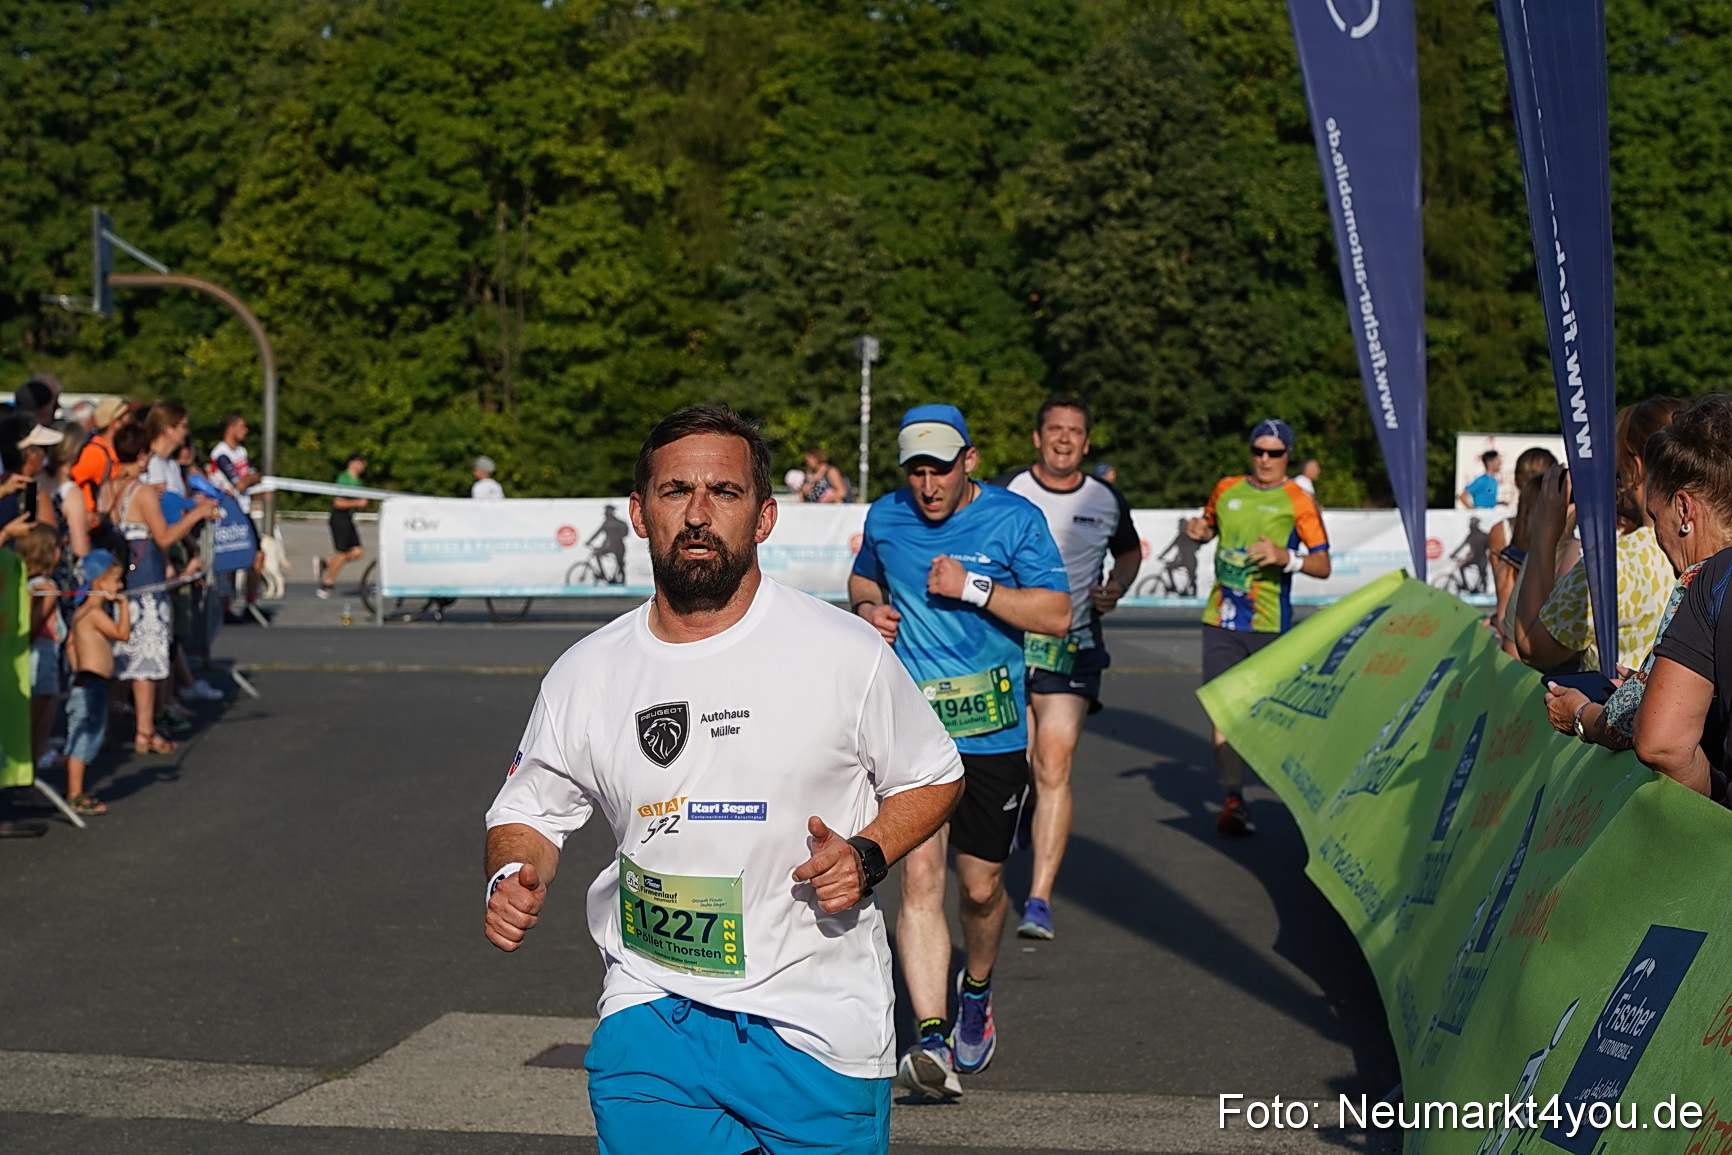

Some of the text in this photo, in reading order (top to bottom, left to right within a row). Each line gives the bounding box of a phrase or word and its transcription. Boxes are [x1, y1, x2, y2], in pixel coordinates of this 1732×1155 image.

[640, 707, 683, 721] PEUGEOT
[700, 709, 750, 724] Autohaus
[933, 694, 986, 719] 1946
[710, 725, 741, 738] Müller
[691, 803, 760, 815] Karl Seger
[640, 886, 678, 900] Firmenlauf
[625, 900, 635, 935] RUN
[635, 899, 718, 943] 1227
[635, 928, 722, 959] Pöllet Thorsten
[723, 919, 737, 965] 2022
[1606, 993, 1656, 1037] Fischer
[1597, 1038, 1634, 1060] AUTOMOBILE
